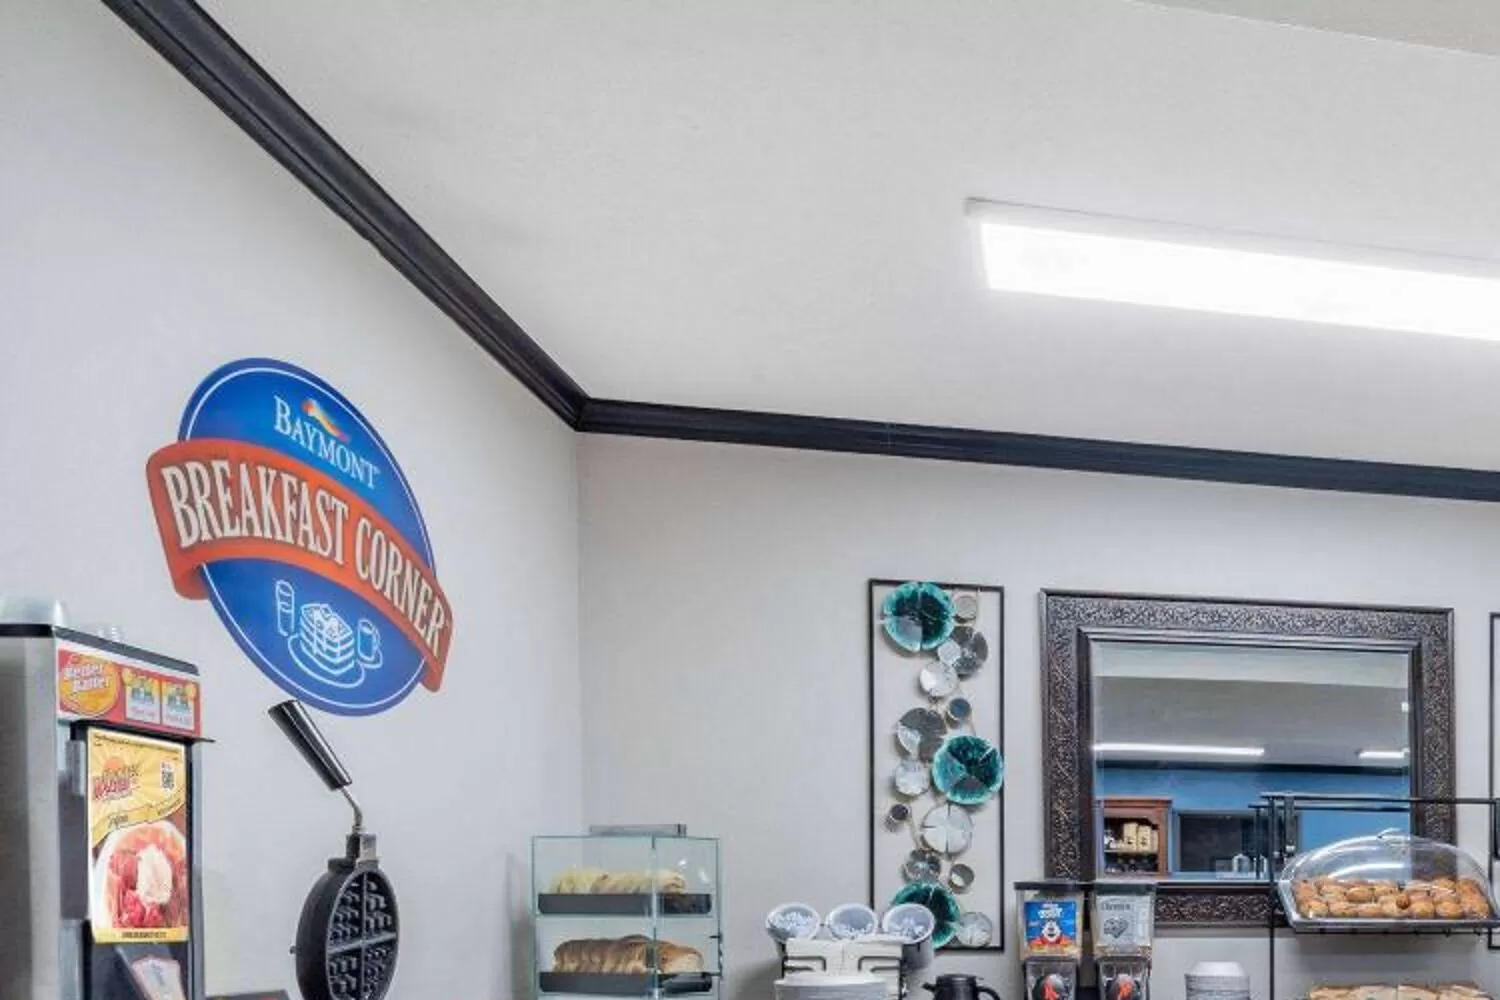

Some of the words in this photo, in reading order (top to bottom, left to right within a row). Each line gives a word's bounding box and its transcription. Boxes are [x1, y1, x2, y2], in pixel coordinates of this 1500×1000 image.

[273, 395, 381, 490] BAYMONT
[160, 459, 350, 565] BREAKFAST
[355, 517, 446, 658] CORNER
